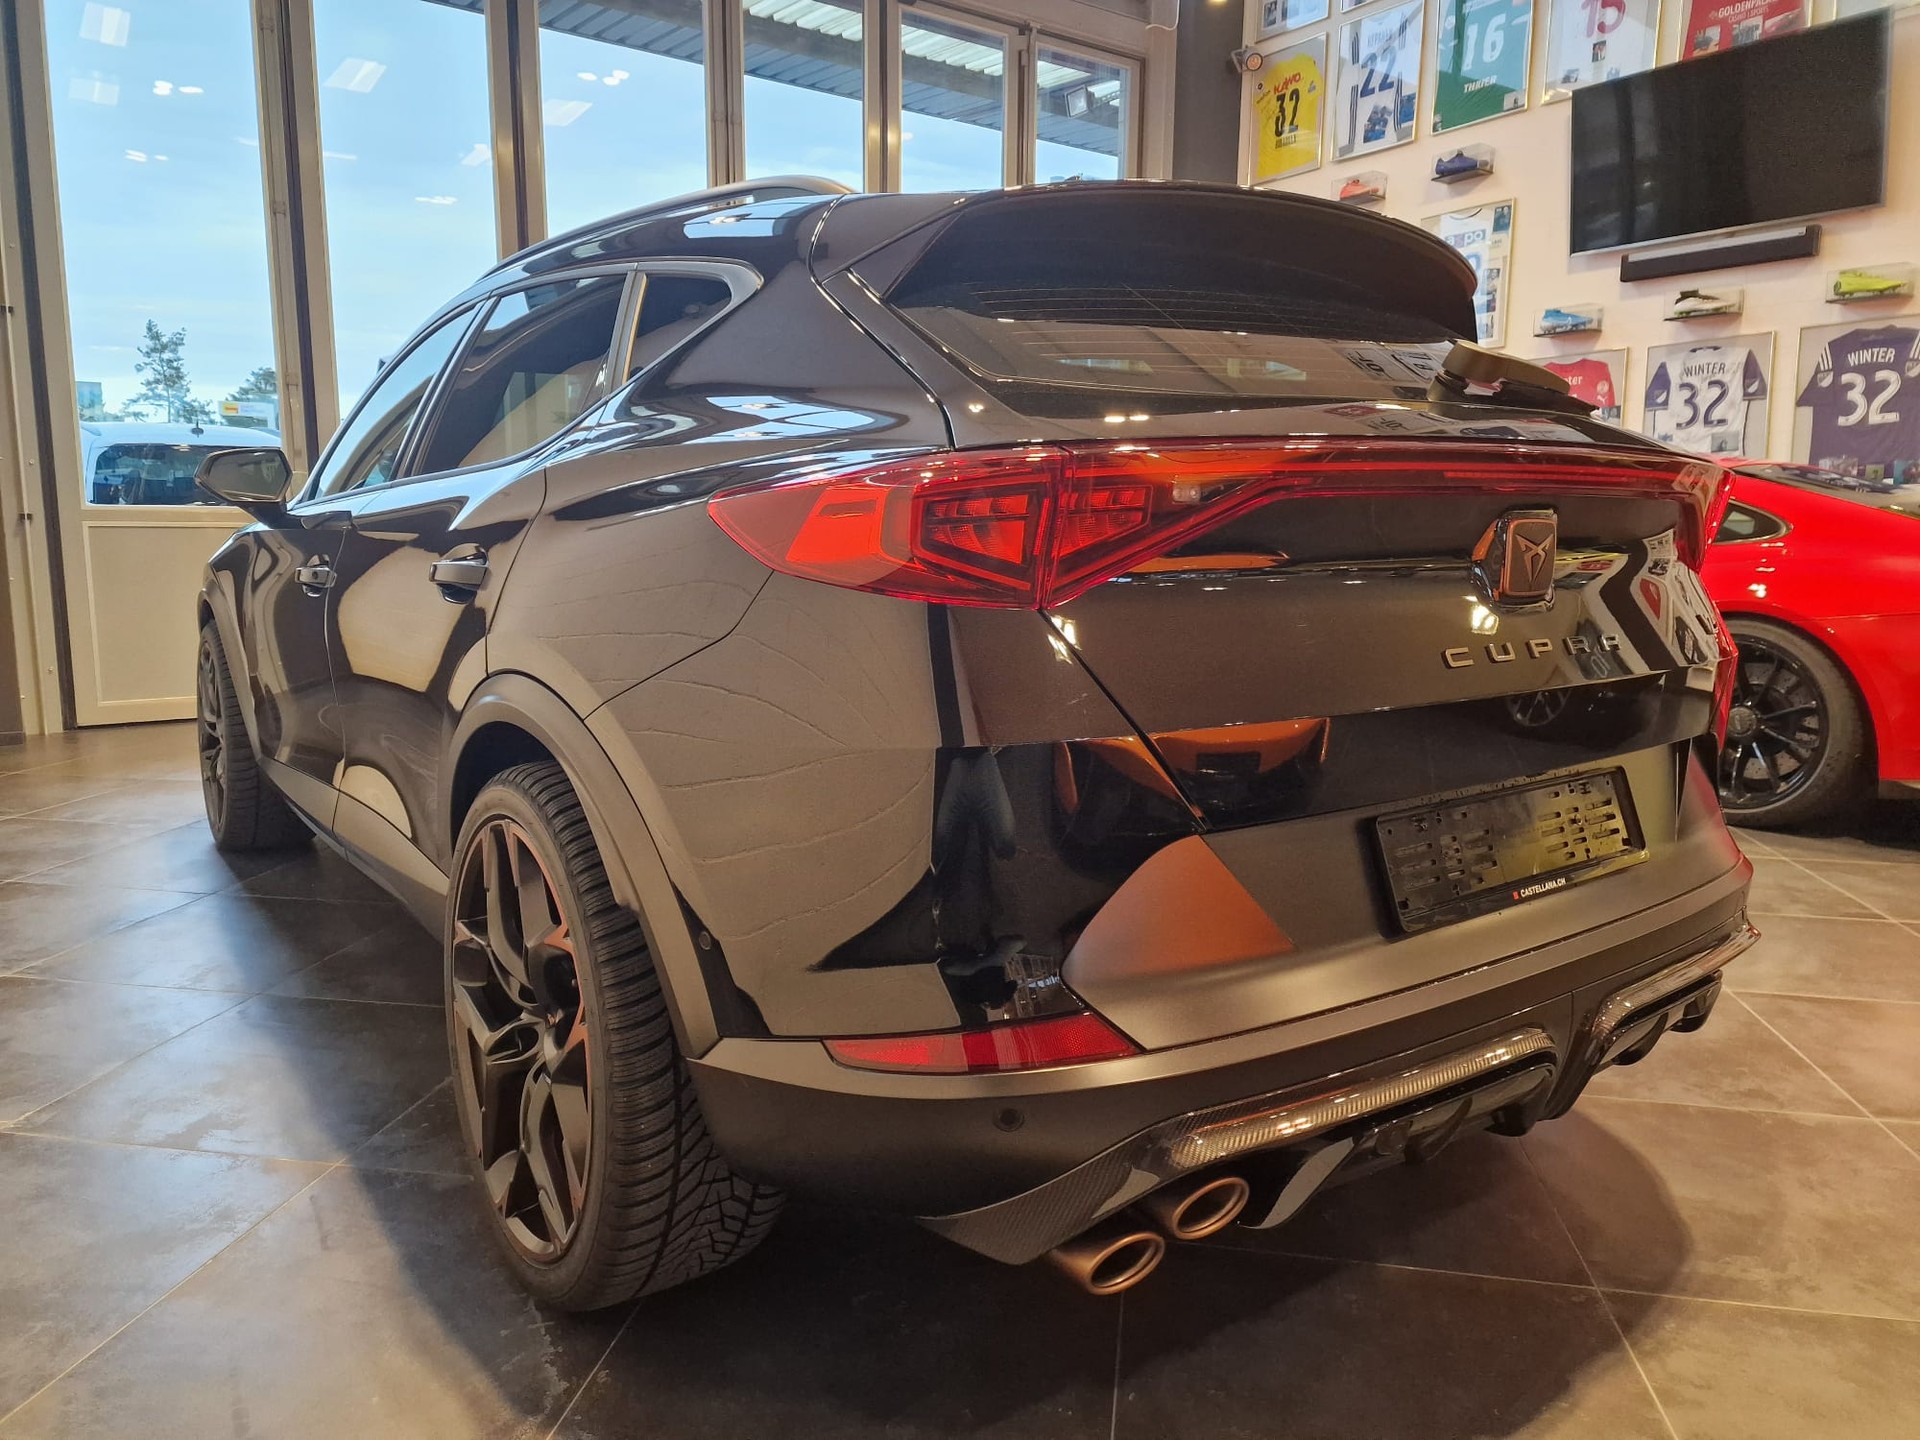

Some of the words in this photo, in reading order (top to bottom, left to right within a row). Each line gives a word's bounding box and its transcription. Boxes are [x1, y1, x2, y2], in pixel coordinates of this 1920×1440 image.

[1462, 13, 1506, 71] 16
[1360, 46, 1397, 98] 22
[1275, 88, 1300, 138] 32
[1684, 362, 1727, 377] WINTER
[1848, 347, 1895, 367] WINTER
[1676, 380, 1729, 431] 32
[1838, 370, 1902, 426] 32
[1442, 633, 1622, 669] CUPRA
